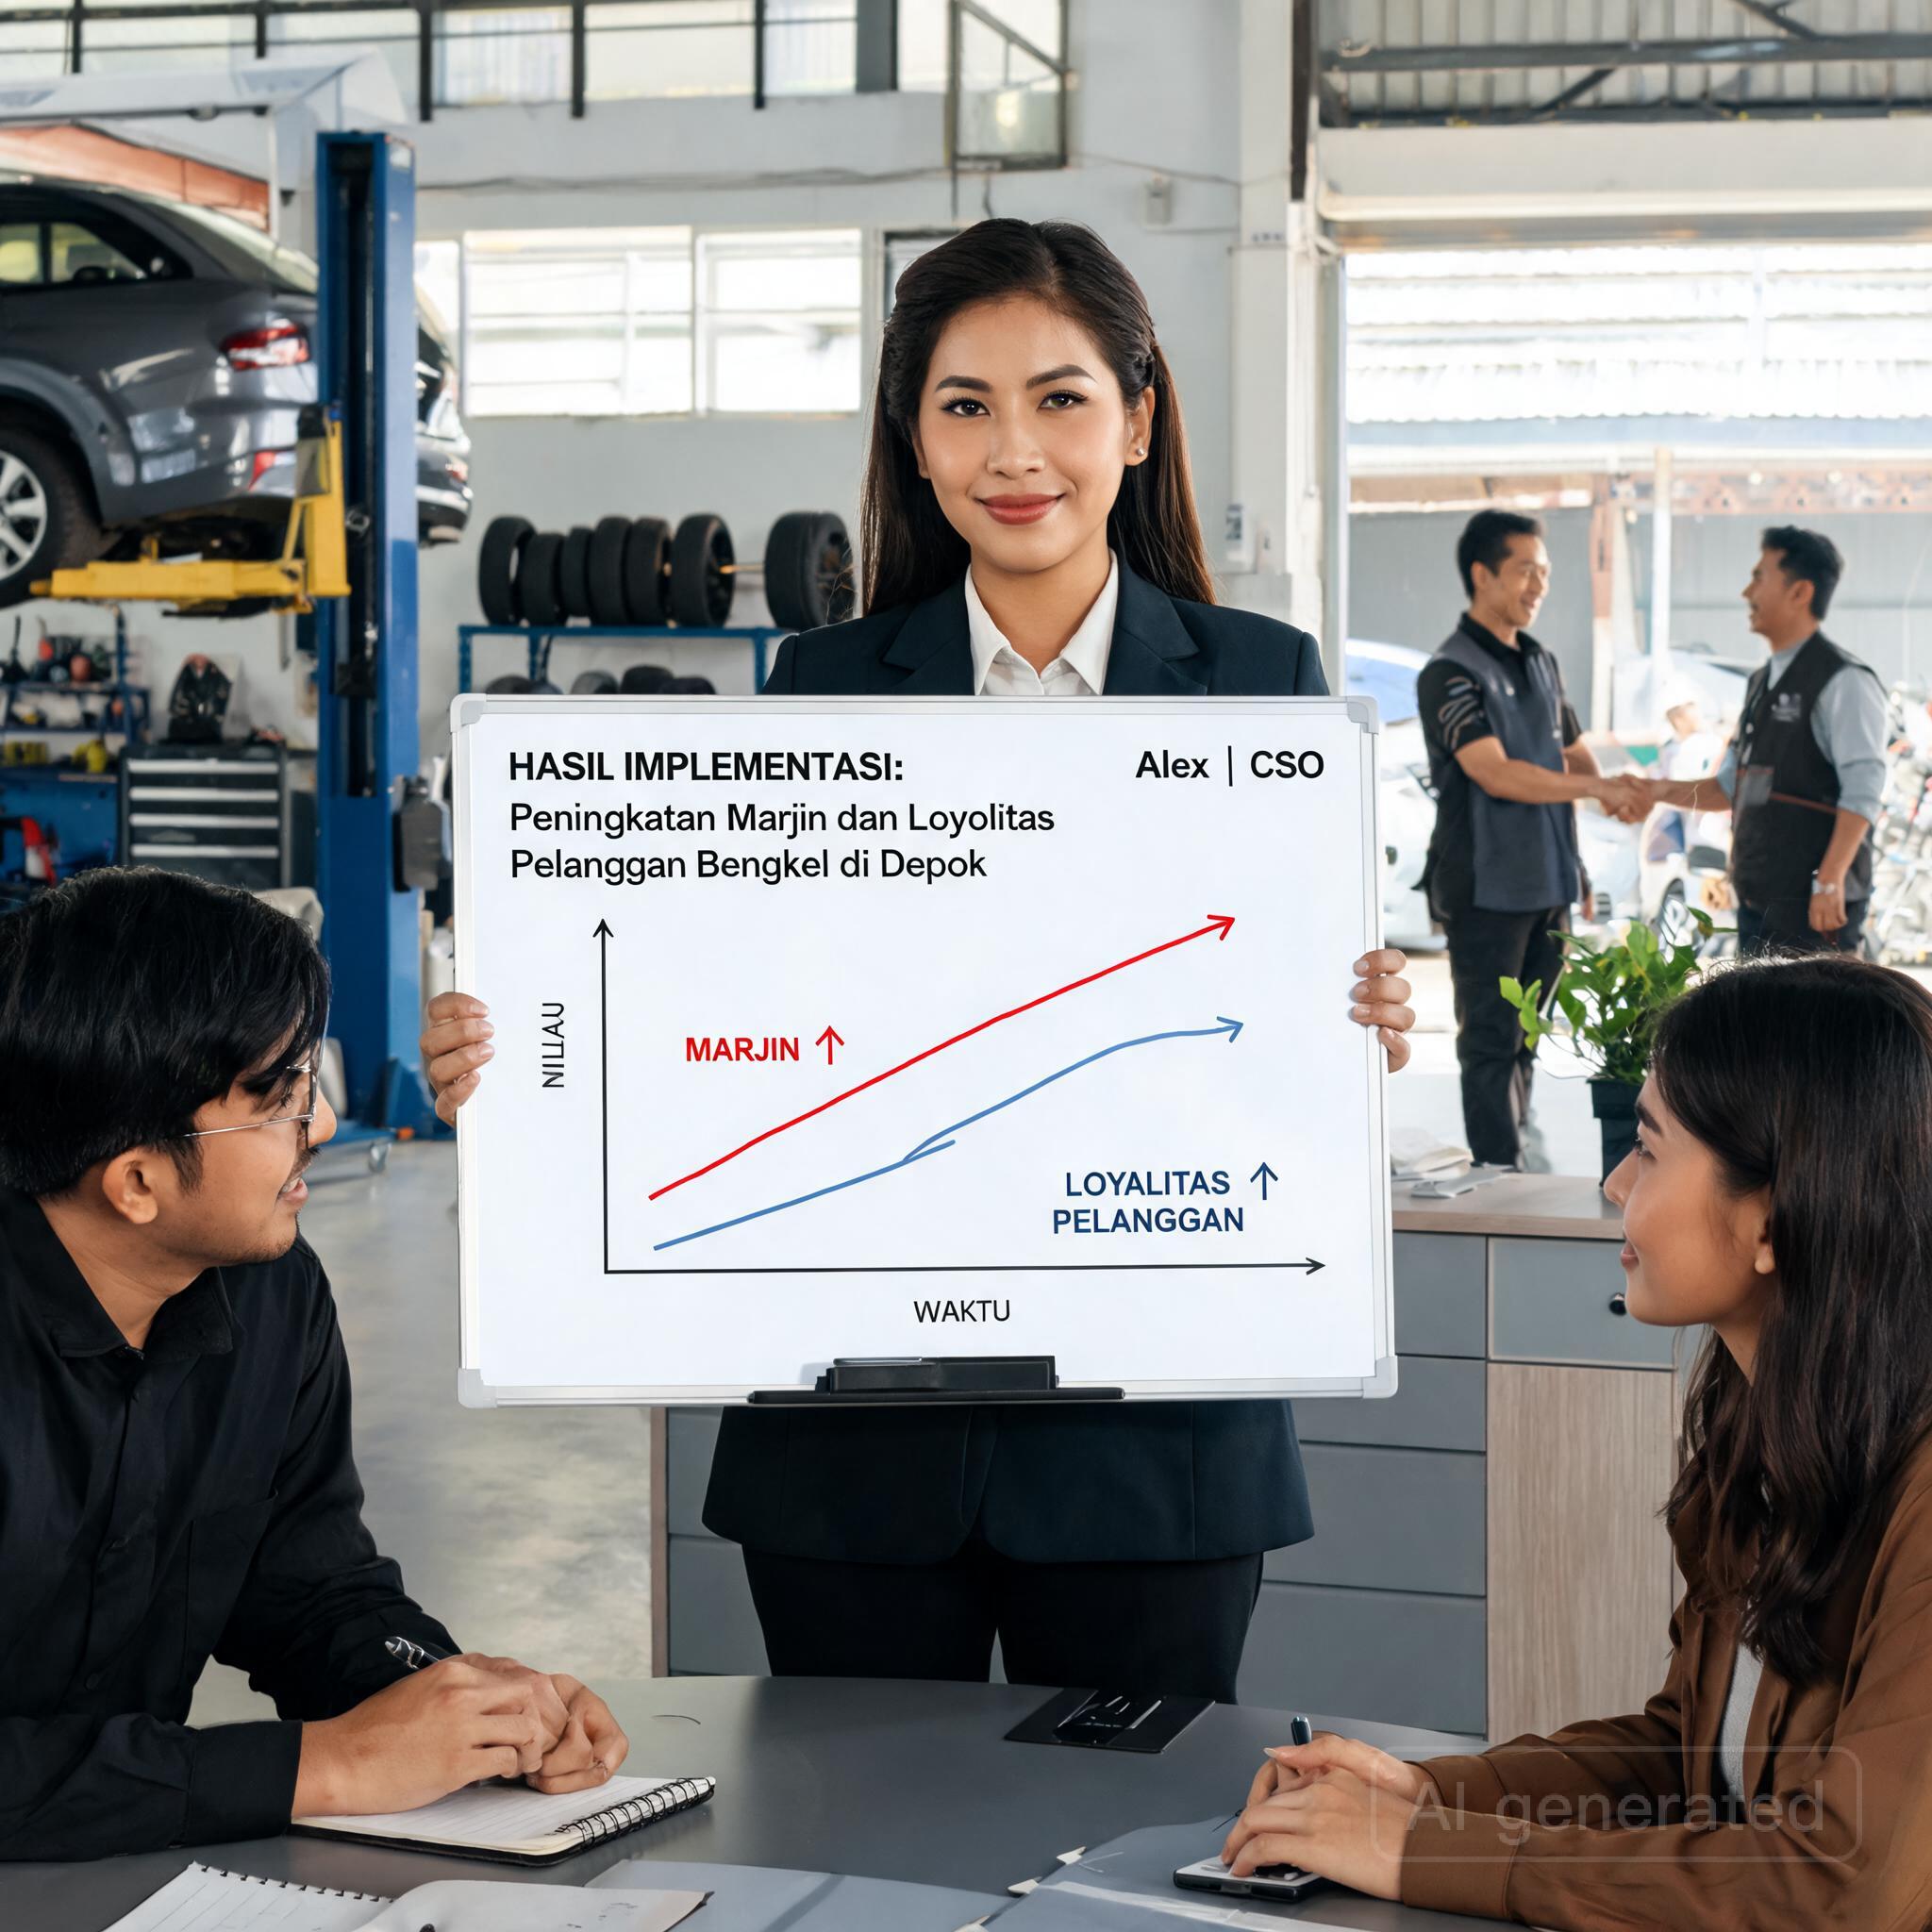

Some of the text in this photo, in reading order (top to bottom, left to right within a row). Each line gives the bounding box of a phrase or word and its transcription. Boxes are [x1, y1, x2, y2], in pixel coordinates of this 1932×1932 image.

[509, 751, 903, 781] HASIL IMPLEMENTASI:
[1135, 749, 1210, 779] Alex
[1250, 750, 1324, 779] CSO
[510, 802, 1056, 841] Peningkatan Marjin dan Loyolitas
[511, 848, 988, 887] Pelanggan Bengkel di Depok
[686, 1037, 800, 1062] MARJIN
[1066, 1170, 1231, 1197] LOYALITAS
[1053, 1207, 1244, 1235] PELANGGAN
[913, 1299, 1010, 1324] WAKTU
